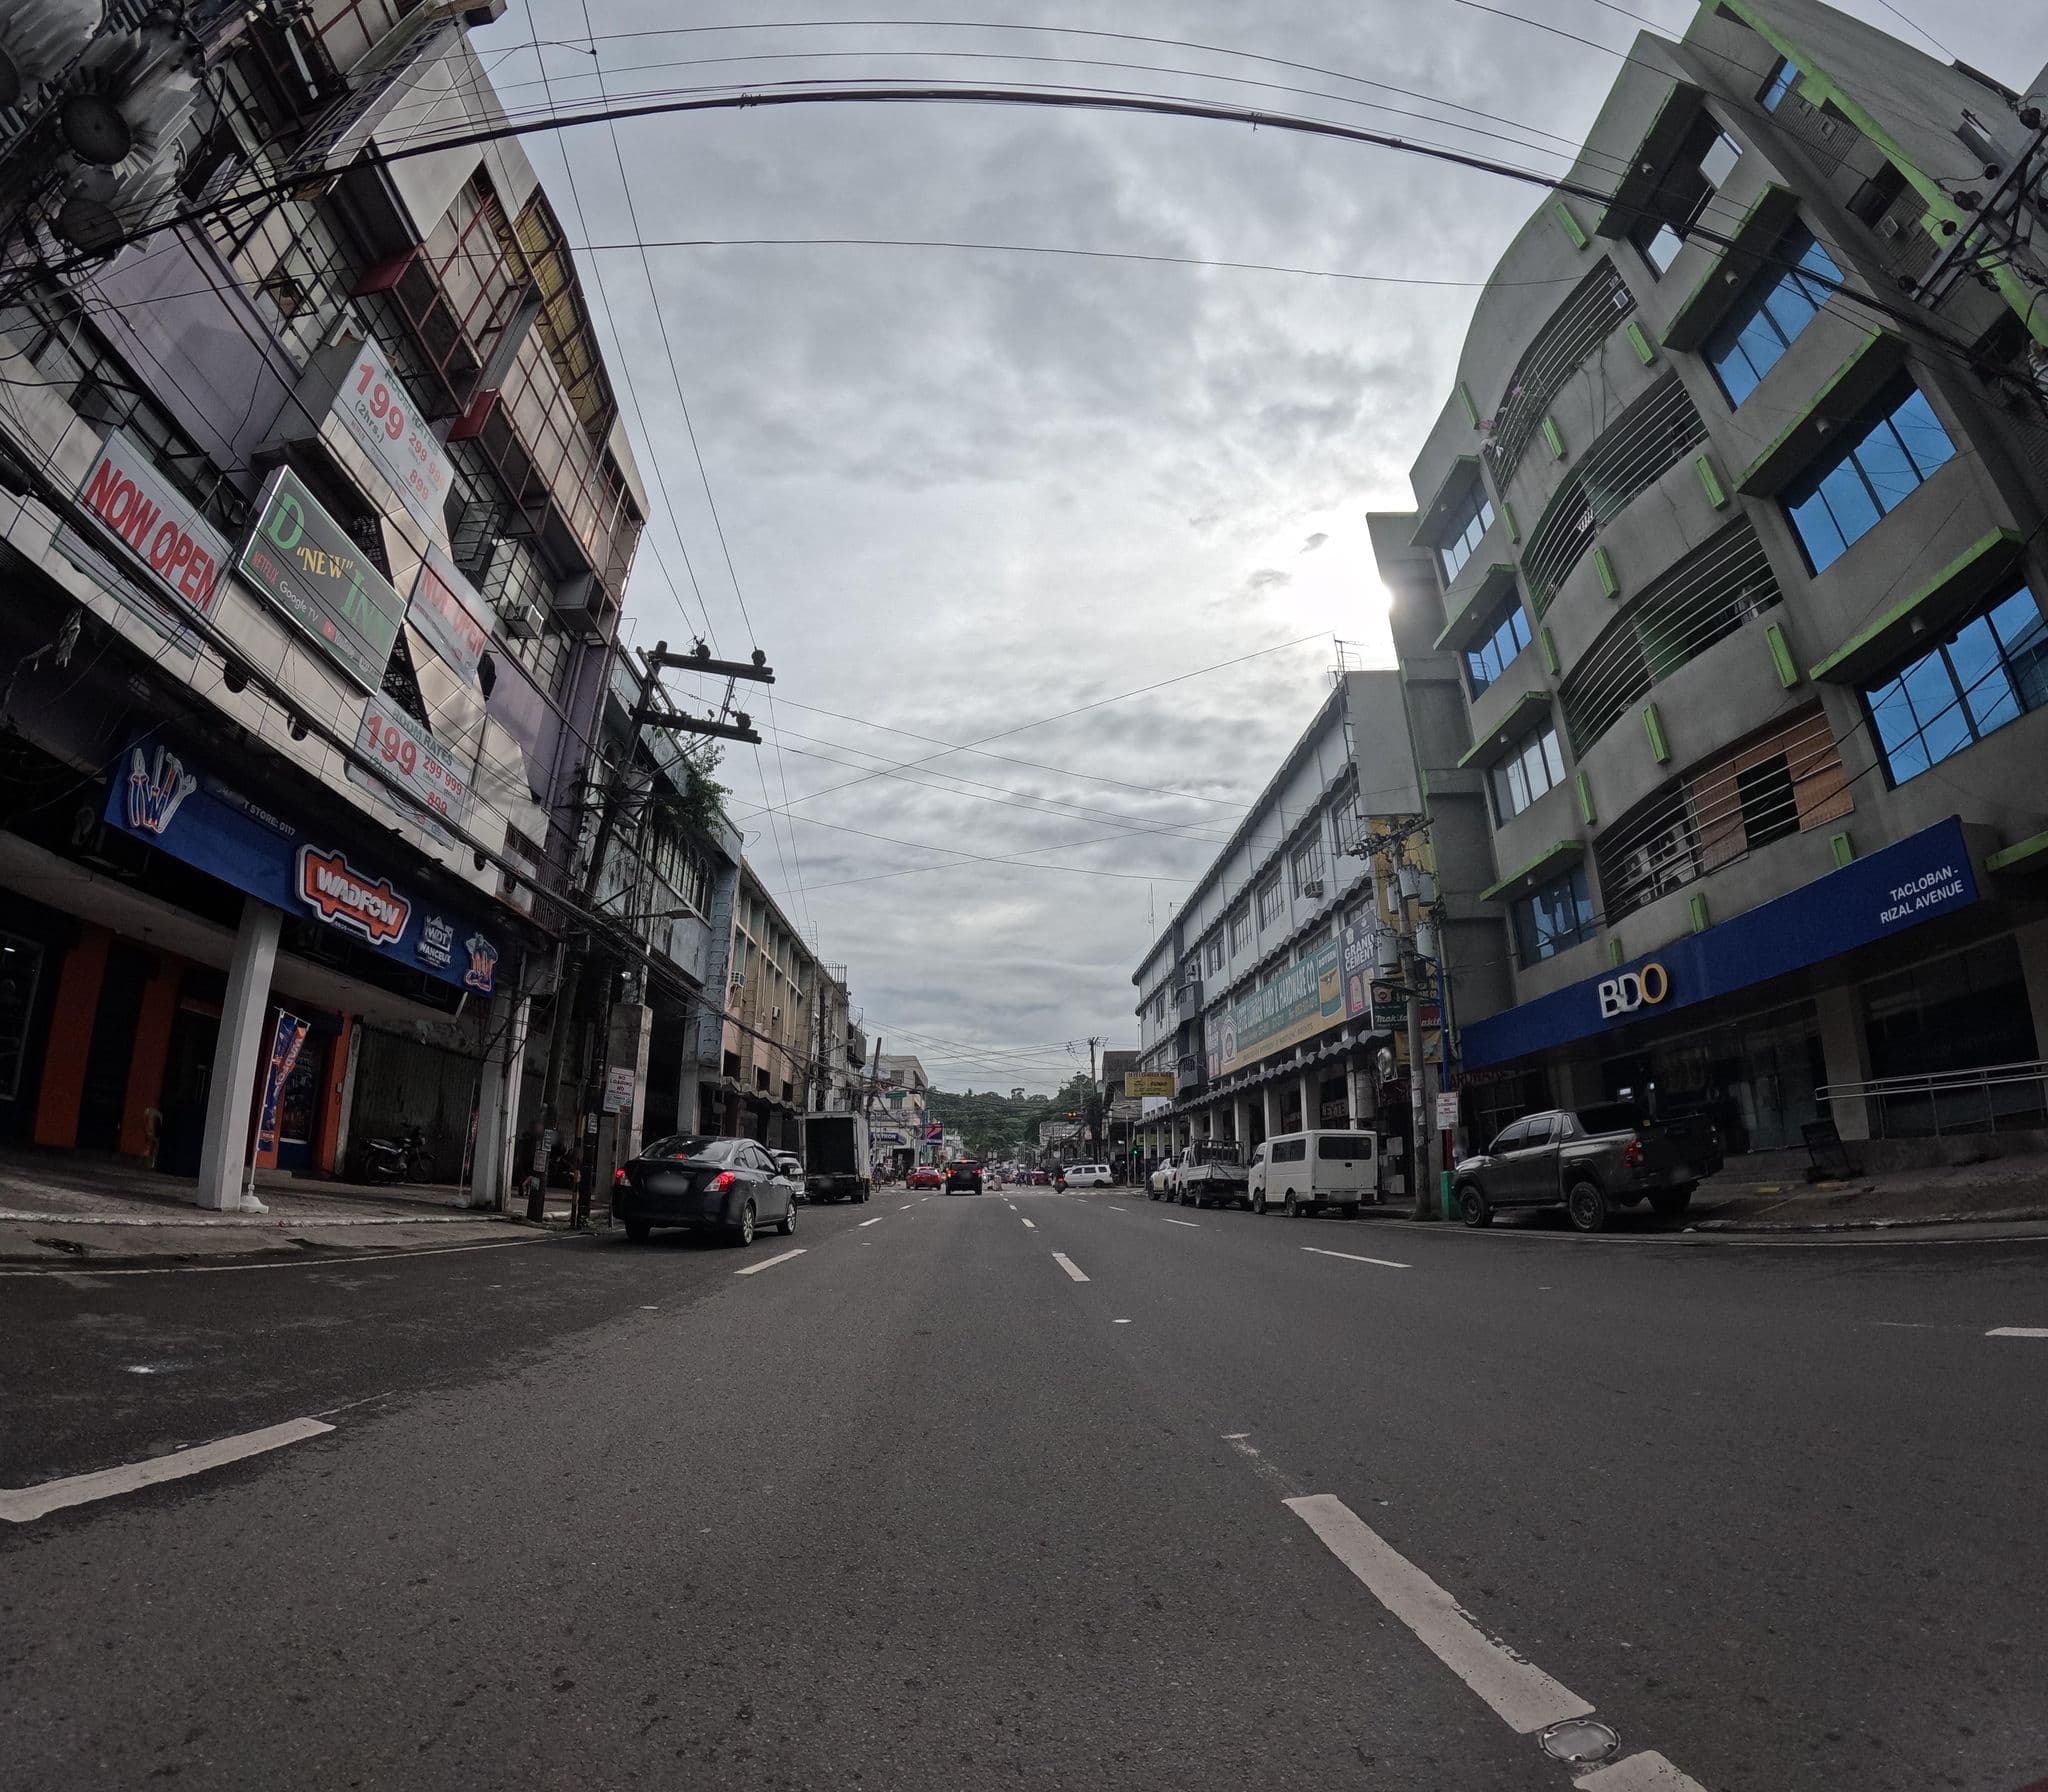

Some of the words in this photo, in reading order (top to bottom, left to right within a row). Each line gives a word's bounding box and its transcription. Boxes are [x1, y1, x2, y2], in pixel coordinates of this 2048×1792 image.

[354, 400, 384, 443] (2hrs.)
[357, 363, 404, 440] 199
[408, 432, 428, 462] 299
[409, 469, 429, 500] 899
[82, 457, 161, 550] NOW
[150, 520, 221, 611] OPEN
[267, 493, 305, 550] D
[252, 552, 280, 585] NETFLIX
[279, 580, 307, 613] Google
[308, 607, 319, 622] TV
[367, 715, 416, 776] 199
[392, 707, 424, 740] ROOM
[423, 735, 453, 767] RATES
[423, 756, 442, 779] 299
[444, 773, 462, 796] 999
[279, 822, 296, 837] 0117
[317, 865, 400, 926] WADFOW
[1880, 901, 1914, 924] RIZAL
[1915, 879, 1964, 910] AVENUE
[1889, 865, 1952, 901] TACLOBAN
[1344, 934, 1374, 959] GRAND
[1345, 946, 1375, 971] CEMENT
[1598, 962, 1668, 1019] BDO
